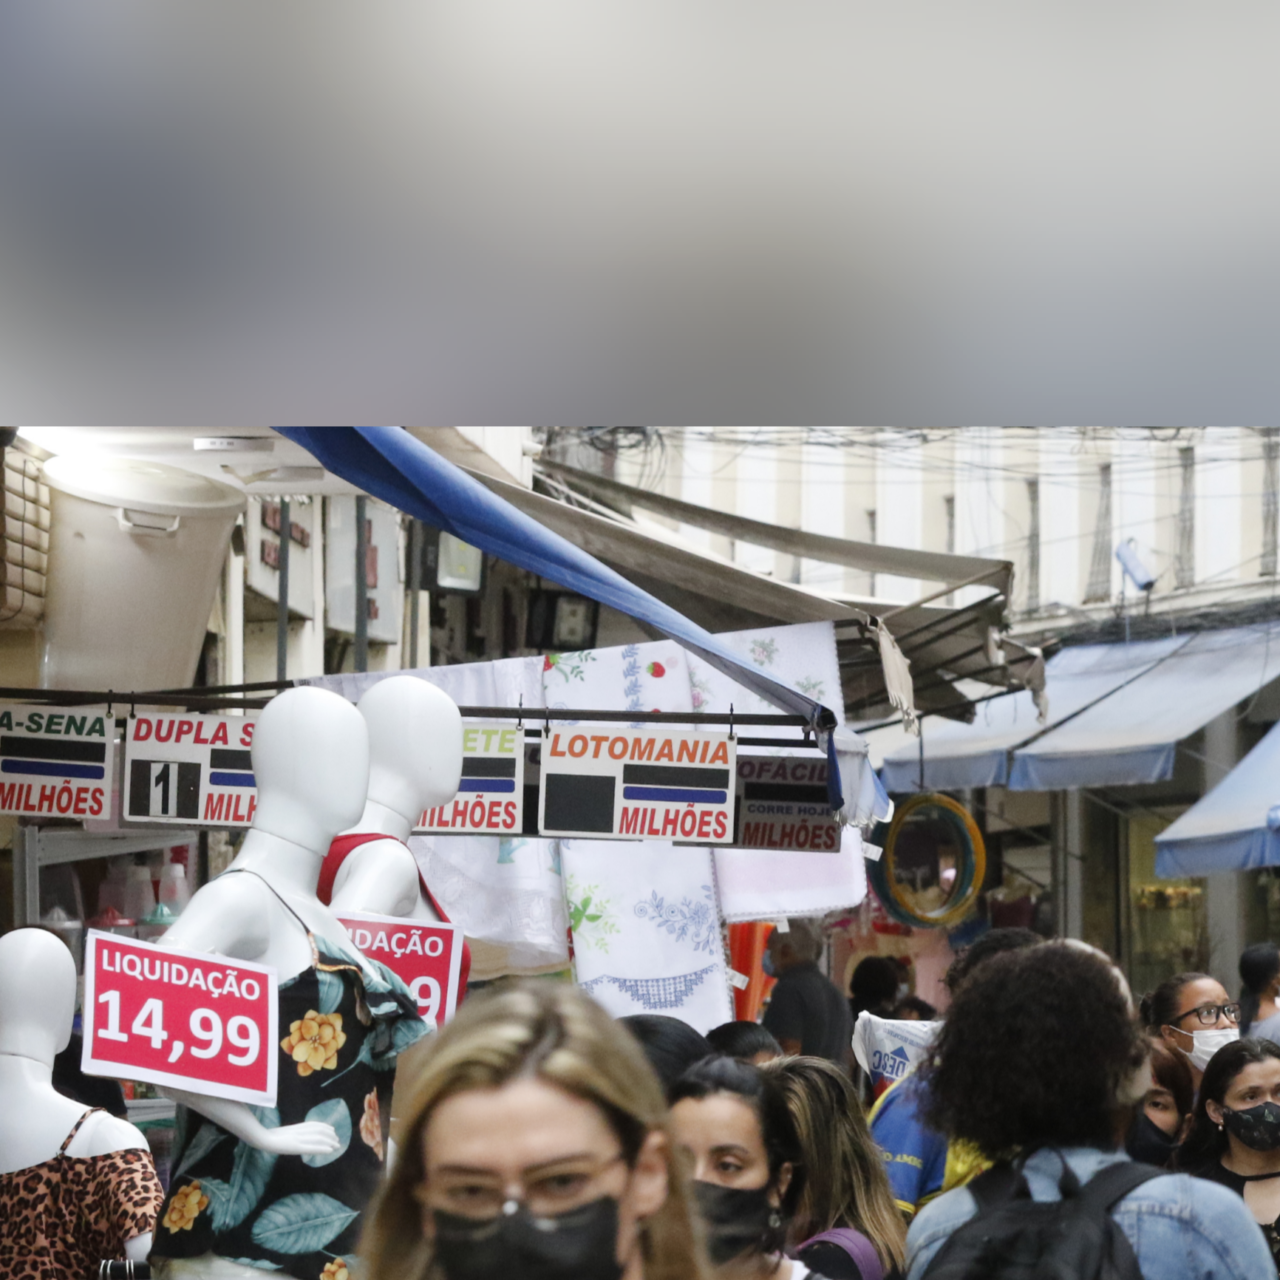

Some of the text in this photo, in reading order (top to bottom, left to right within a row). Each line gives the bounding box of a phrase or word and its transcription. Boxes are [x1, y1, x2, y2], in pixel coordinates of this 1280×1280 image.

[0, 711, 105, 737] A-SENA
[133, 718, 229, 746] DUPLA
[463, 728, 517, 753] ETE
[549, 733, 730, 765] LOTOMANIA
[737, 758, 828, 782] OFÁCIL
[0, 779, 105, 816] MILHÕES
[155, 763, 170, 815] 1
[203, 793, 257, 822] MILH
[619, 803, 728, 839] MILHÕES
[747, 804, 832, 817] CORRE HOJE
[742, 819, 837, 850] MILHÕES
[102, 948, 261, 1001] LIQUIDAÇÃO
[97, 990, 261, 1067] 14,99
